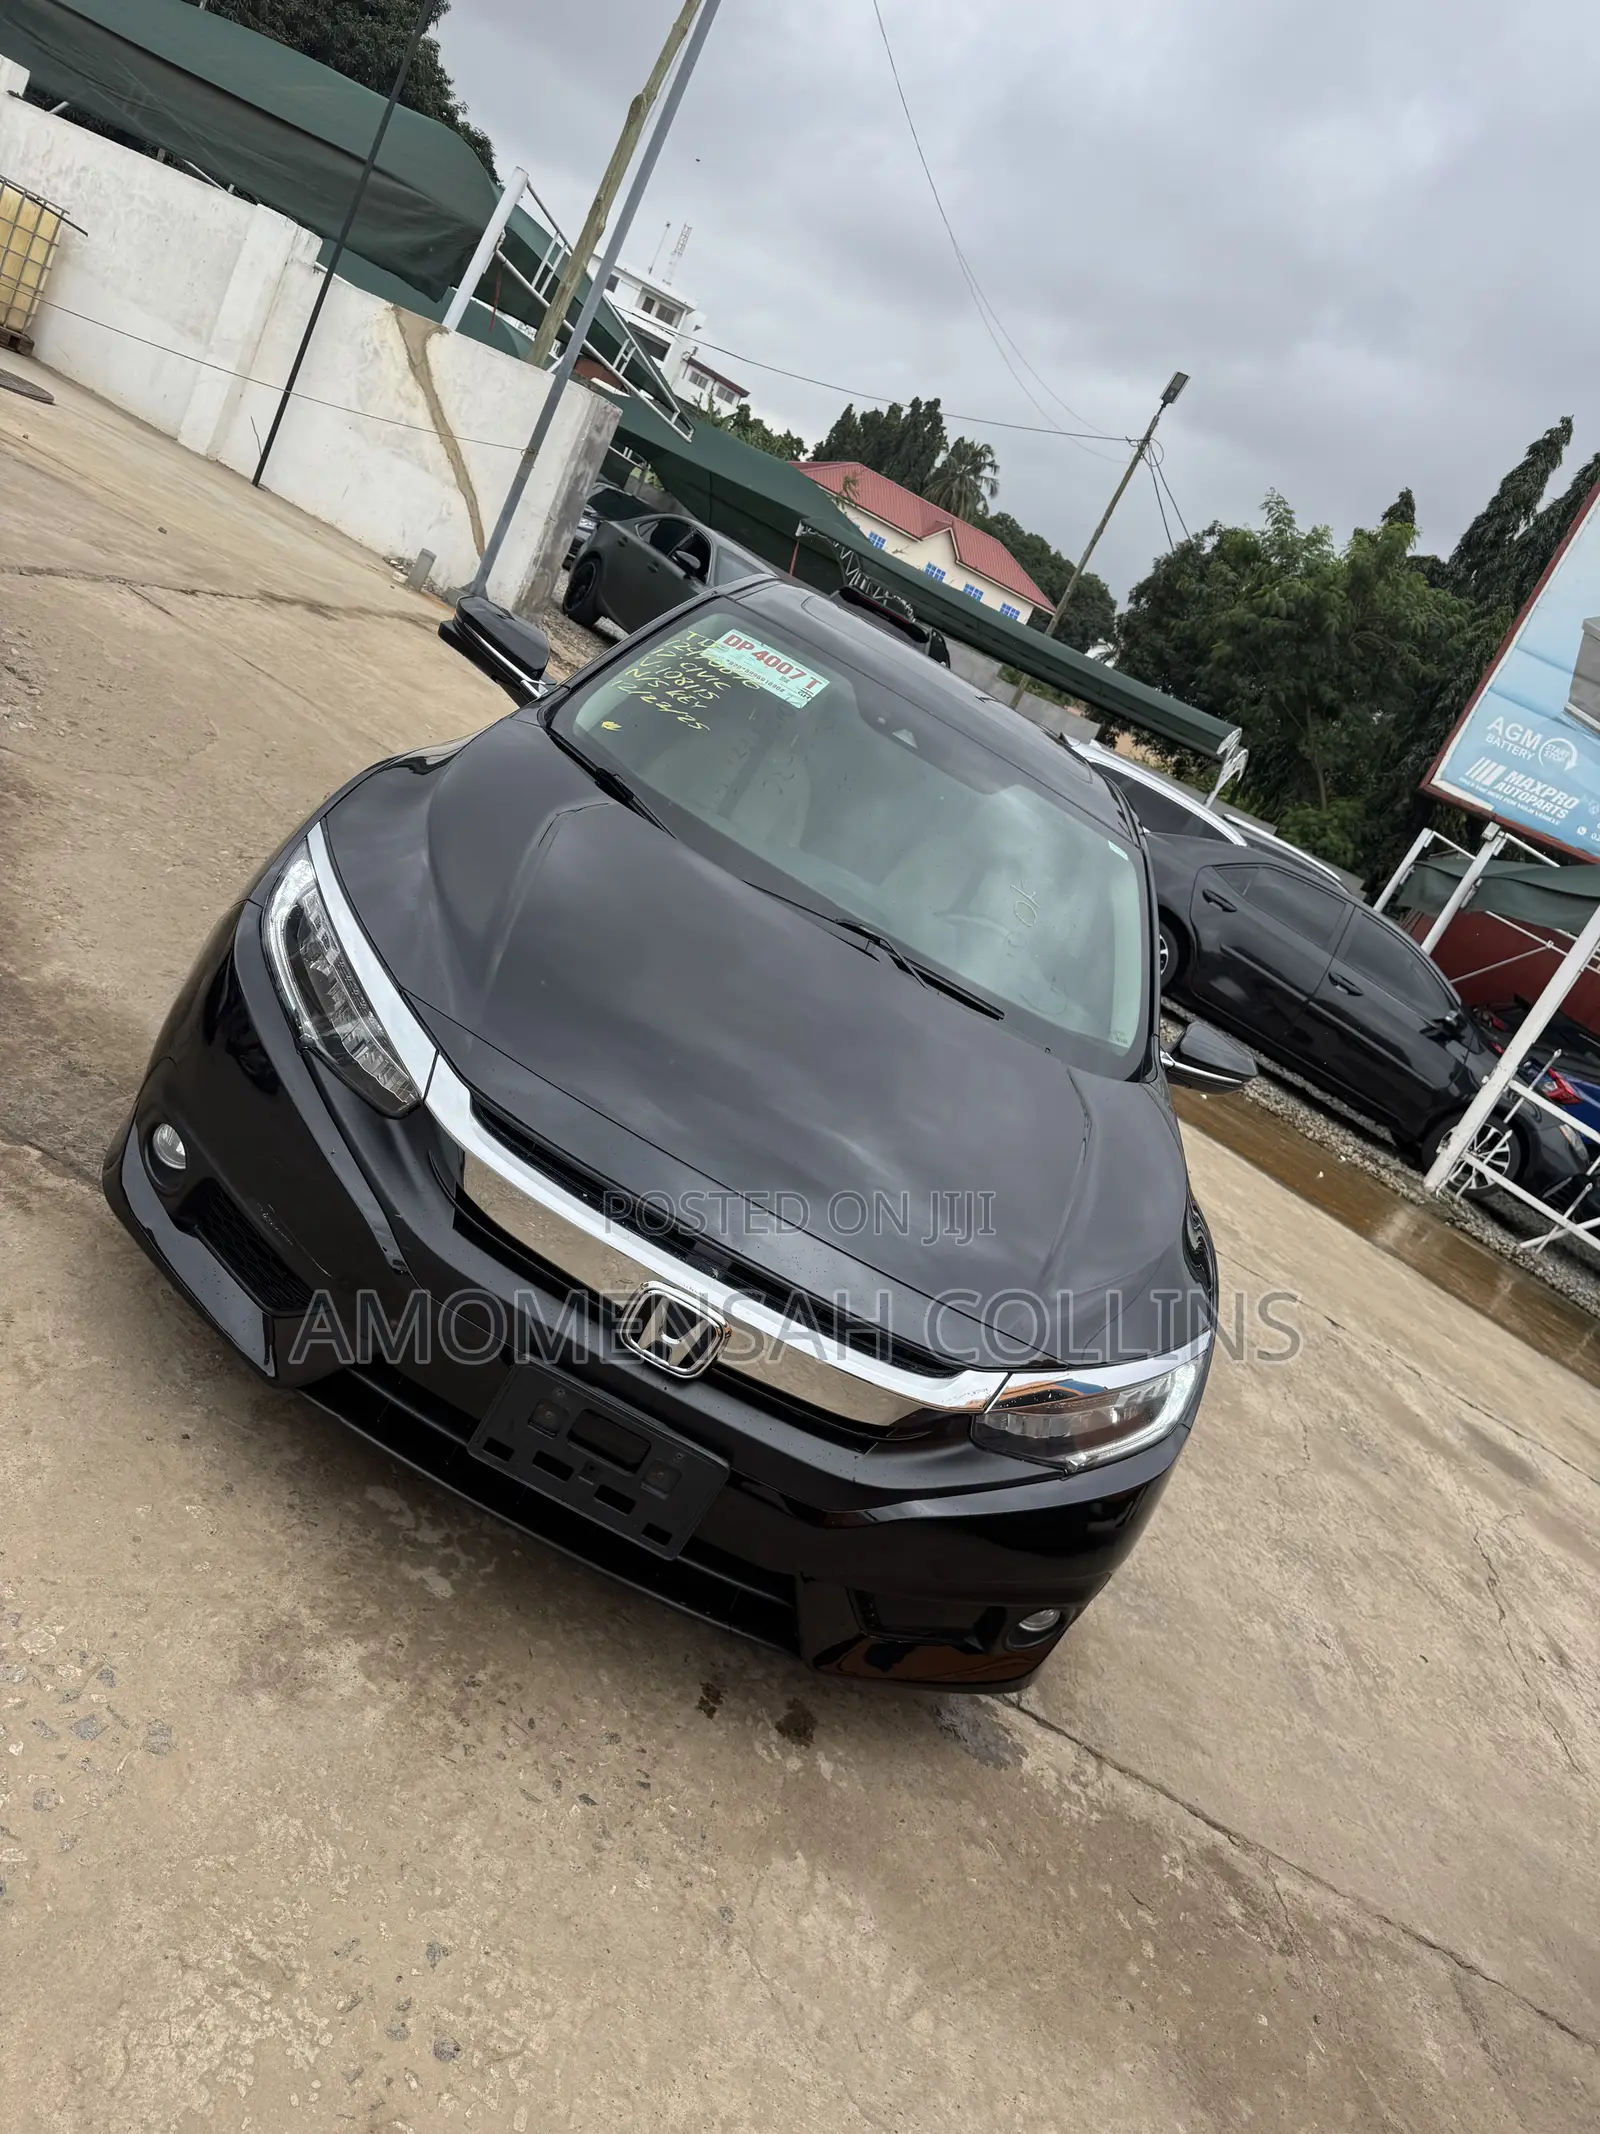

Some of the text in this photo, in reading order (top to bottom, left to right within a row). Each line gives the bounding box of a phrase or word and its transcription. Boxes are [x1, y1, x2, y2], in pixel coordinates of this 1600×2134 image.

[682, 661, 732, 691] CIVIC
[723, 633, 755, 656] DP
[752, 647, 808, 682] 4007
[805, 674, 824, 690] T
[1484, 732, 1537, 762] BATTERY
[1486, 716, 1543, 751] AGM
[1491, 781, 1570, 820] AUTOPARTS
[1503, 769, 1581, 811] MAXPRO
